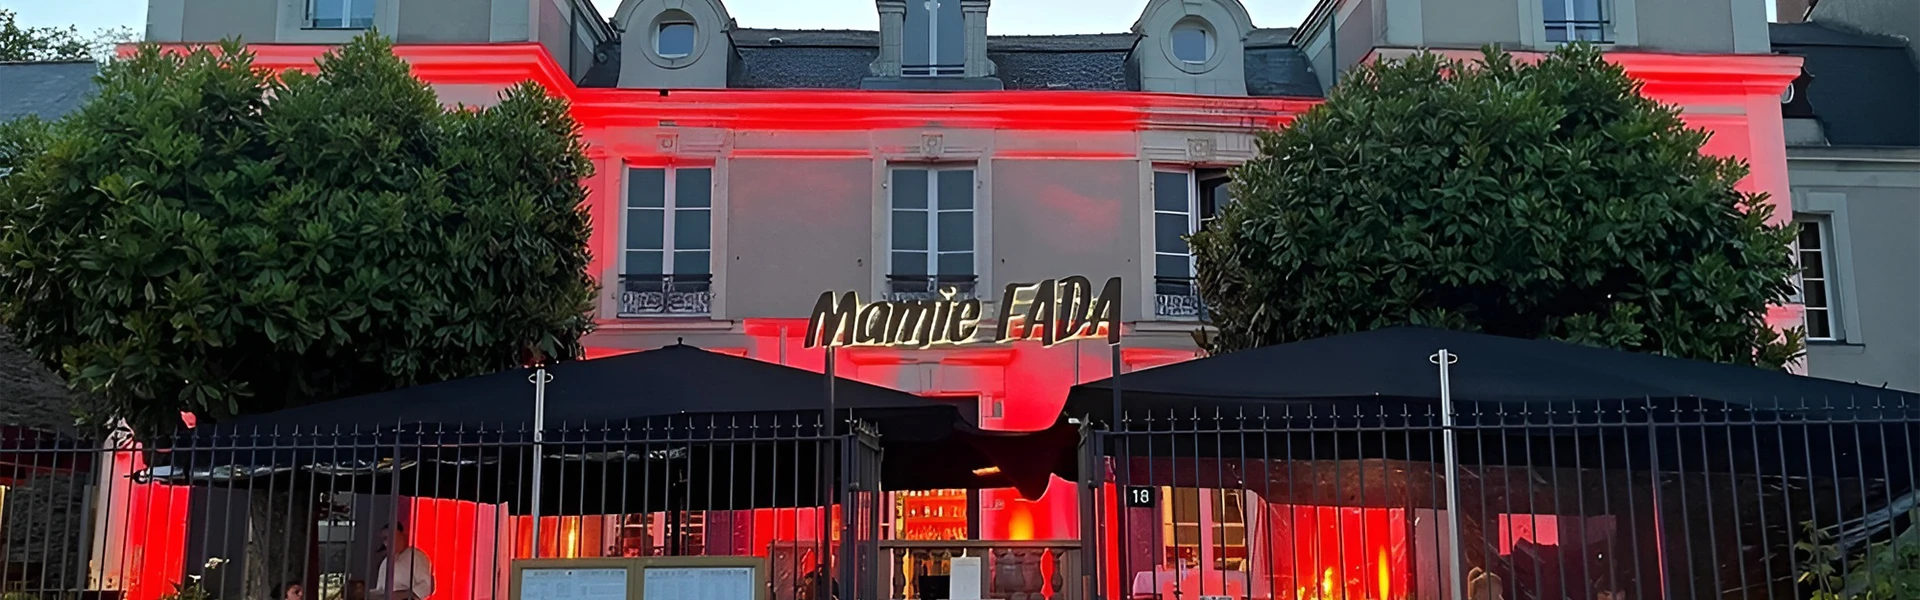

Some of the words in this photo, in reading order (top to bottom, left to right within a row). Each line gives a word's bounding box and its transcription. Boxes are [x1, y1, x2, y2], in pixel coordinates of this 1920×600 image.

[804, 286, 981, 349] Mamie
[995, 276, 1121, 347] FADA
[1132, 489, 1150, 503] 18
